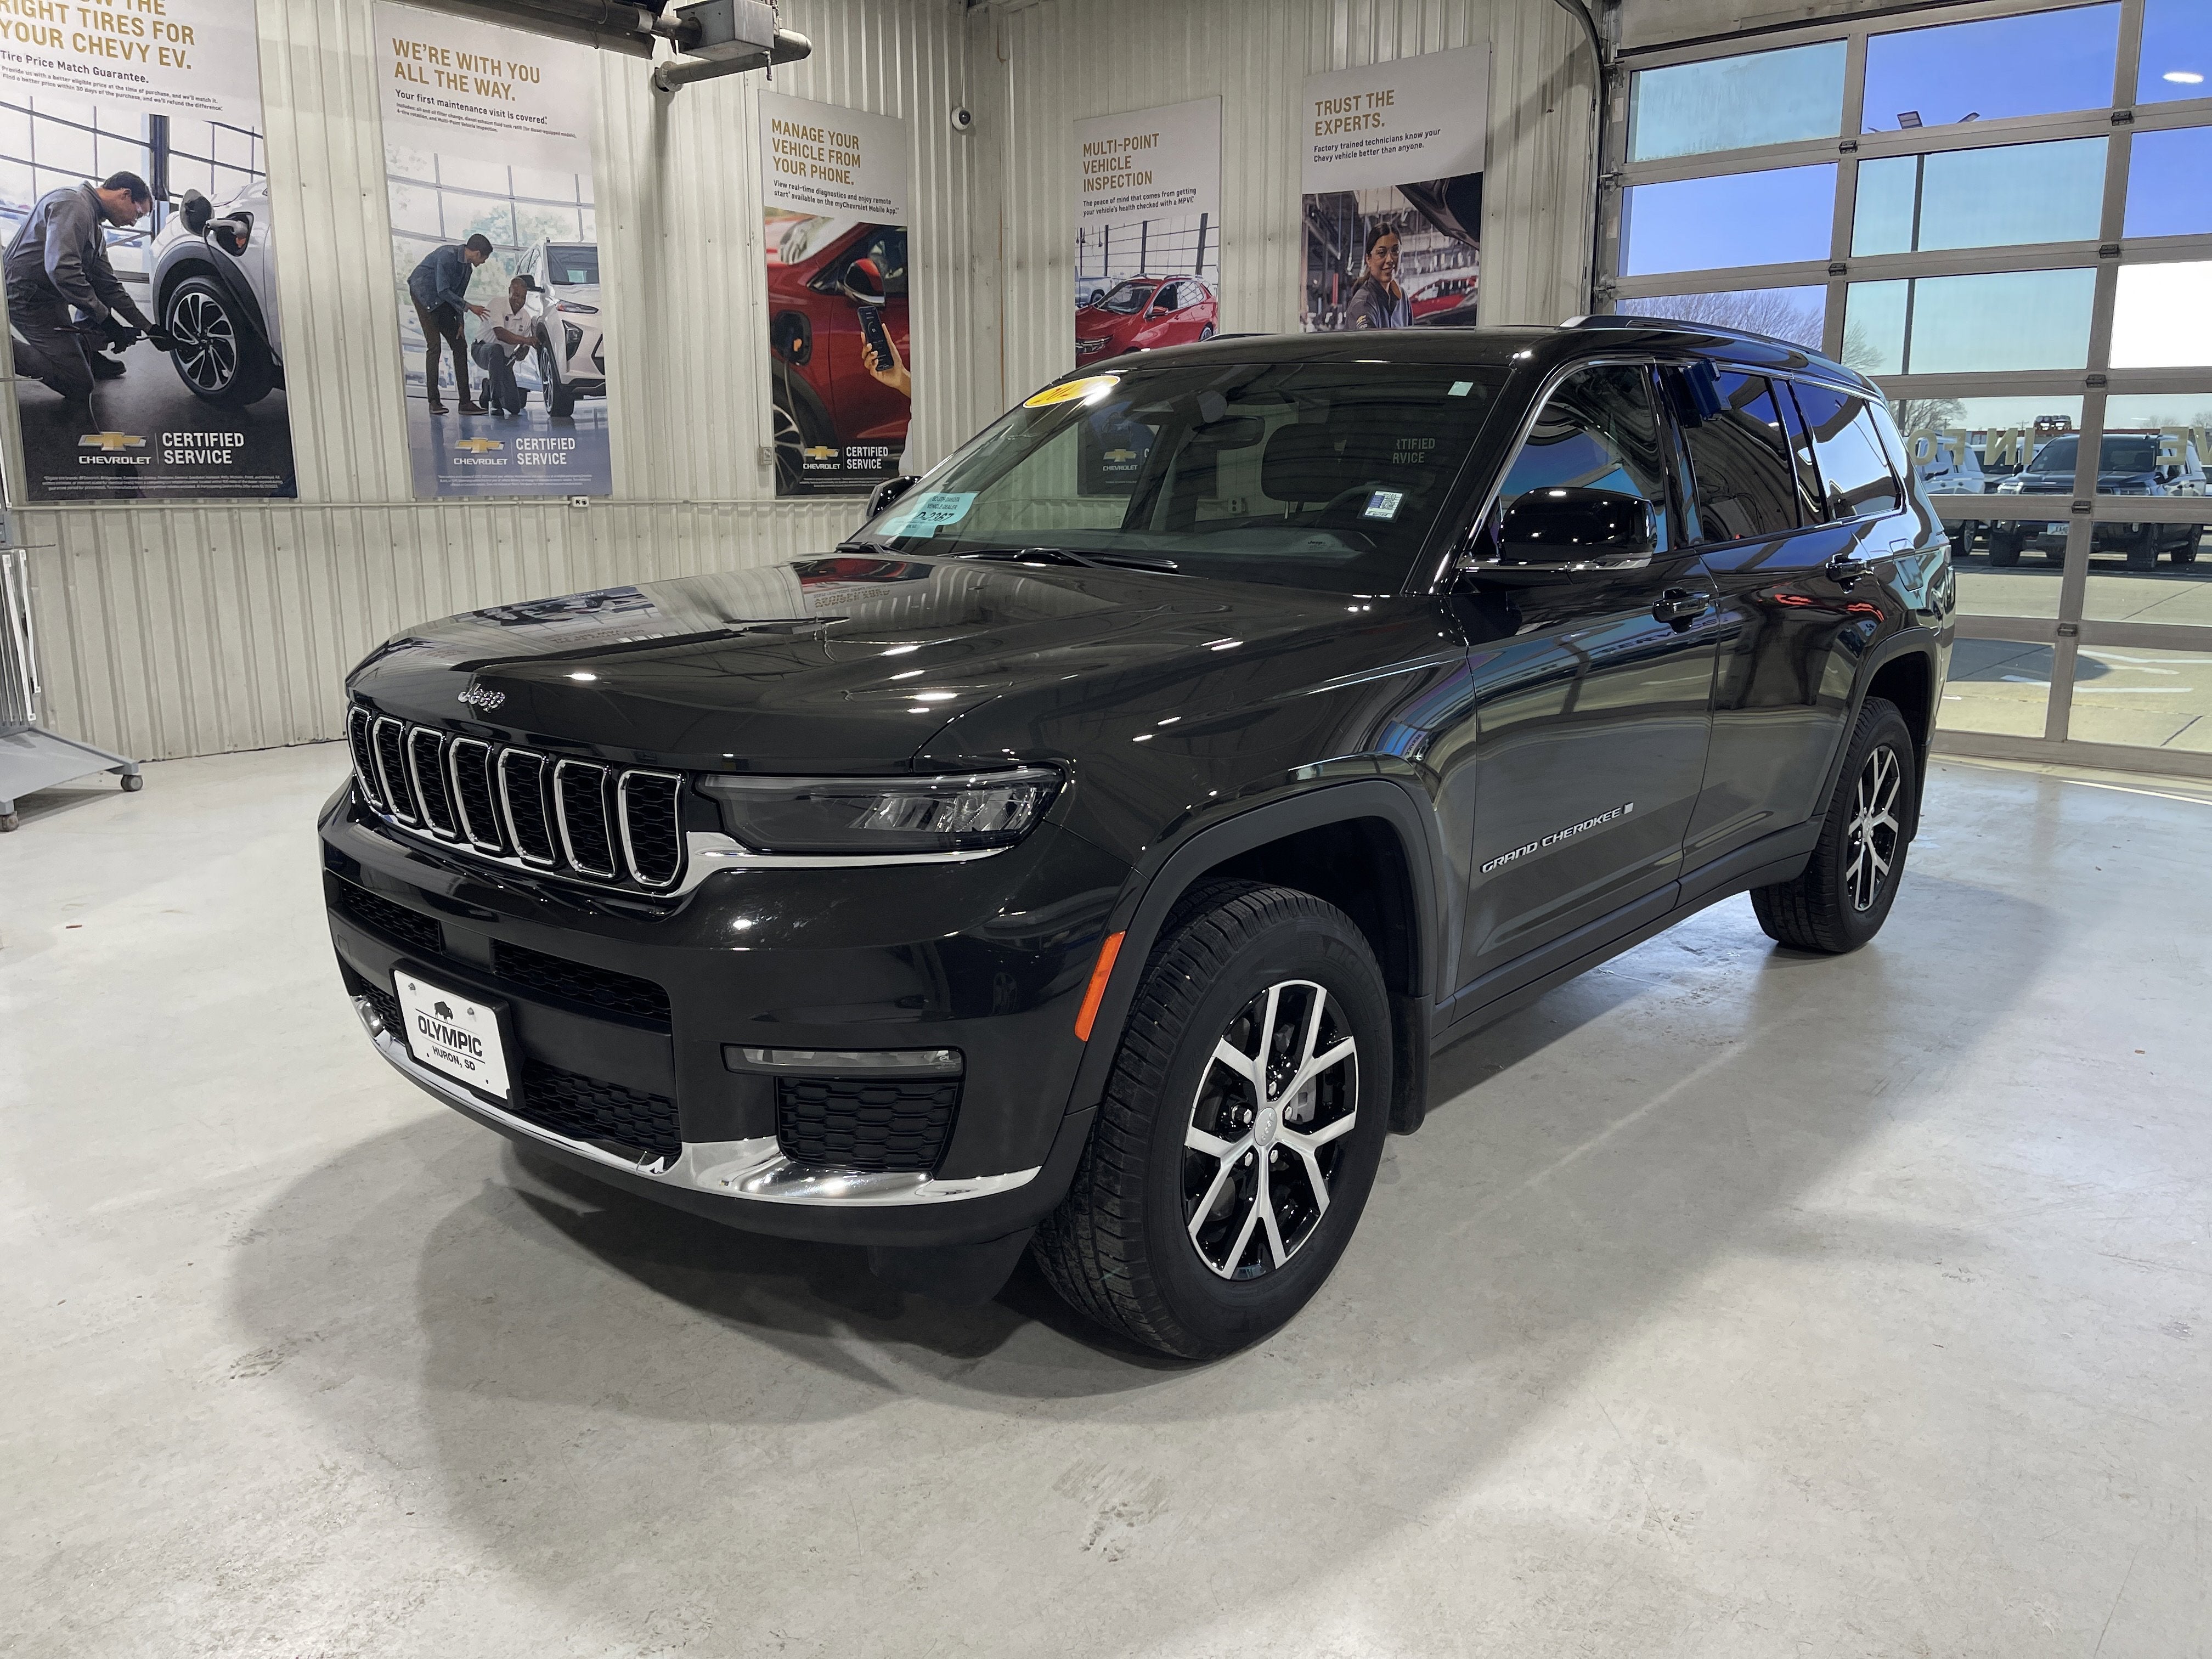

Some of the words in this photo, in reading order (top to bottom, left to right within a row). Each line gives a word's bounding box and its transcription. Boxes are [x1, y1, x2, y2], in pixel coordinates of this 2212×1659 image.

[0, 0, 70, 24] RIGHT
[77, 7, 144, 37] TIRES
[153, 20, 195, 46] FOR
[0, 18, 65, 49] YOUR
[72, 32, 150, 63] CHEVY
[159, 46, 191, 69] EV.
[0, 50, 22, 63] Tire
[26, 54, 54, 68] Price
[57, 60, 89, 75] Match
[93, 66, 149, 83] Guarantee.
[2, 66, 24, 74] Provide
[392, 38, 451, 67] WE'RE
[456, 52, 501, 77] WITH
[506, 62, 540, 83] YOU
[395, 62, 430, 84] ALL
[434, 69, 469, 93] THE
[474, 77, 515, 101] WAY.
[116, 93, 142, 101] purchase,
[395, 89, 414, 100] Your
[417, 94, 435, 105] first
[437, 100, 487, 115] maintenance
[489, 108, 506, 118] visit
[507, 111, 514, 119] is
[1315, 95, 1362, 117] TRUST
[1365, 89, 1395, 109] THE
[771, 118, 825, 144] MANAGE
[828, 131, 859, 150] YOUR
[1315, 112, 1385, 136] EXPERTS.
[1083, 133, 1159, 157] MULTI-POINT
[1314, 143, 1339, 153] Factory
[1340, 140, 1363, 149] trained
[1365, 135, 1403, 146] technicians
[1405, 132, 1423, 140] know
[1425, 128, 1441, 139] your
[1335, 151, 1357, 160] vehicle
[1359, 148, 1380, 157] better
[1381, 145, 1396, 154] than
[1398, 142, 1425, 153] anyone.
[772, 138, 825, 162] VEHICLE
[828, 149, 861, 168] FROM
[772, 156, 806, 177] YOUR
[810, 163, 854, 185] PHONE.
[1083, 155, 1131, 174] VEHICLE
[774, 179, 787, 188] View
[789, 184, 814, 194] real-time
[816, 188, 847, 199] diagnostics
[858, 195, 872, 204] enjoy
[1084, 171, 1152, 192] INSPECTION
[792, 194, 815, 203] available
[834, 201, 868, 211] myChevrolet
[1093, 198, 1109, 207] peace
[1176, 187, 1197, 197] getting
[1083, 210, 1094, 218] your
[1096, 205, 1118, 215] vehicle's
[1119, 203, 1136, 212] health
[1137, 200, 1159, 210] checked
[162, 432, 245, 447] CERTIFIED
[516, 437, 576, 451] CERTIFIED
[1397, 438, 1436, 450] TIFIED
[78, 456, 152, 465] CHEVROLET
[163, 449, 233, 464] SERVICE
[453, 458, 508, 466] CHEVROLET
[517, 452, 567, 465] SERVICE
[846, 446, 888, 458] CERTIFIED
[1392, 452, 1425, 464] RVICE
[847, 458, 882, 470] SERVICE
[458, 684, 505, 712] Jeep
[1481, 841, 1538, 874] GRAND
[1541, 807, 1621, 847] CHEROKEE
[417, 1014, 483, 1057] OLYMPIC
[432, 1045, 462, 1068] HURON,
[464, 1058, 476, 1071] SD
